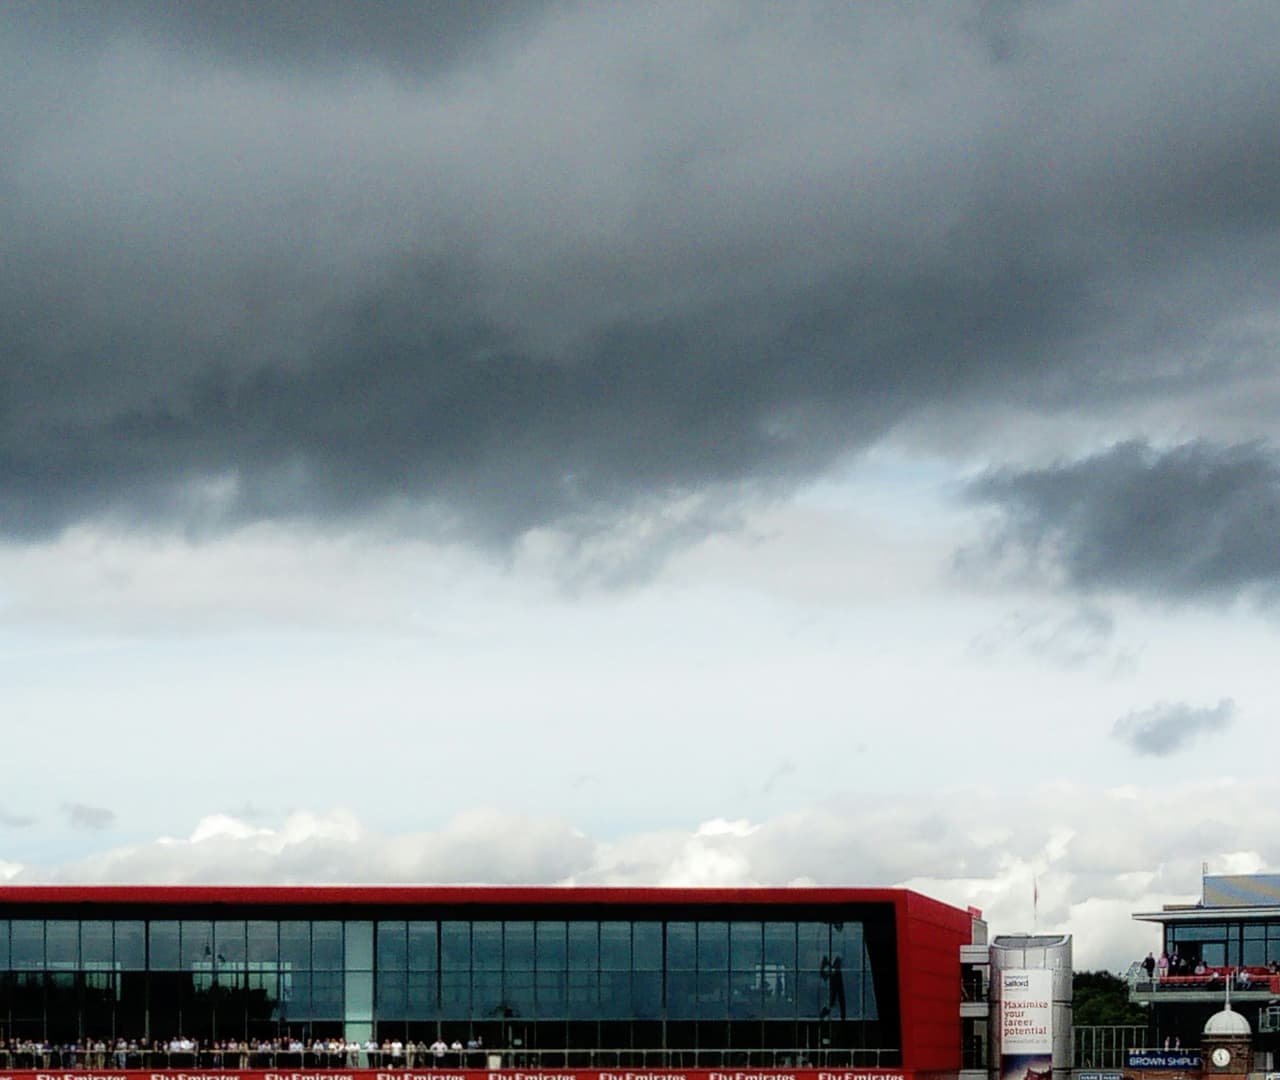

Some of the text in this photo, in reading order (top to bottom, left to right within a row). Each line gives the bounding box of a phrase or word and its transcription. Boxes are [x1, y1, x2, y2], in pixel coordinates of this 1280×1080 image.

[1004, 1001, 1049, 1009] Maximise
[1004, 1011, 1025, 1019] your
[1004, 1027, 1047, 1037] potential
[1129, 1057, 1166, 1066] BROWN
